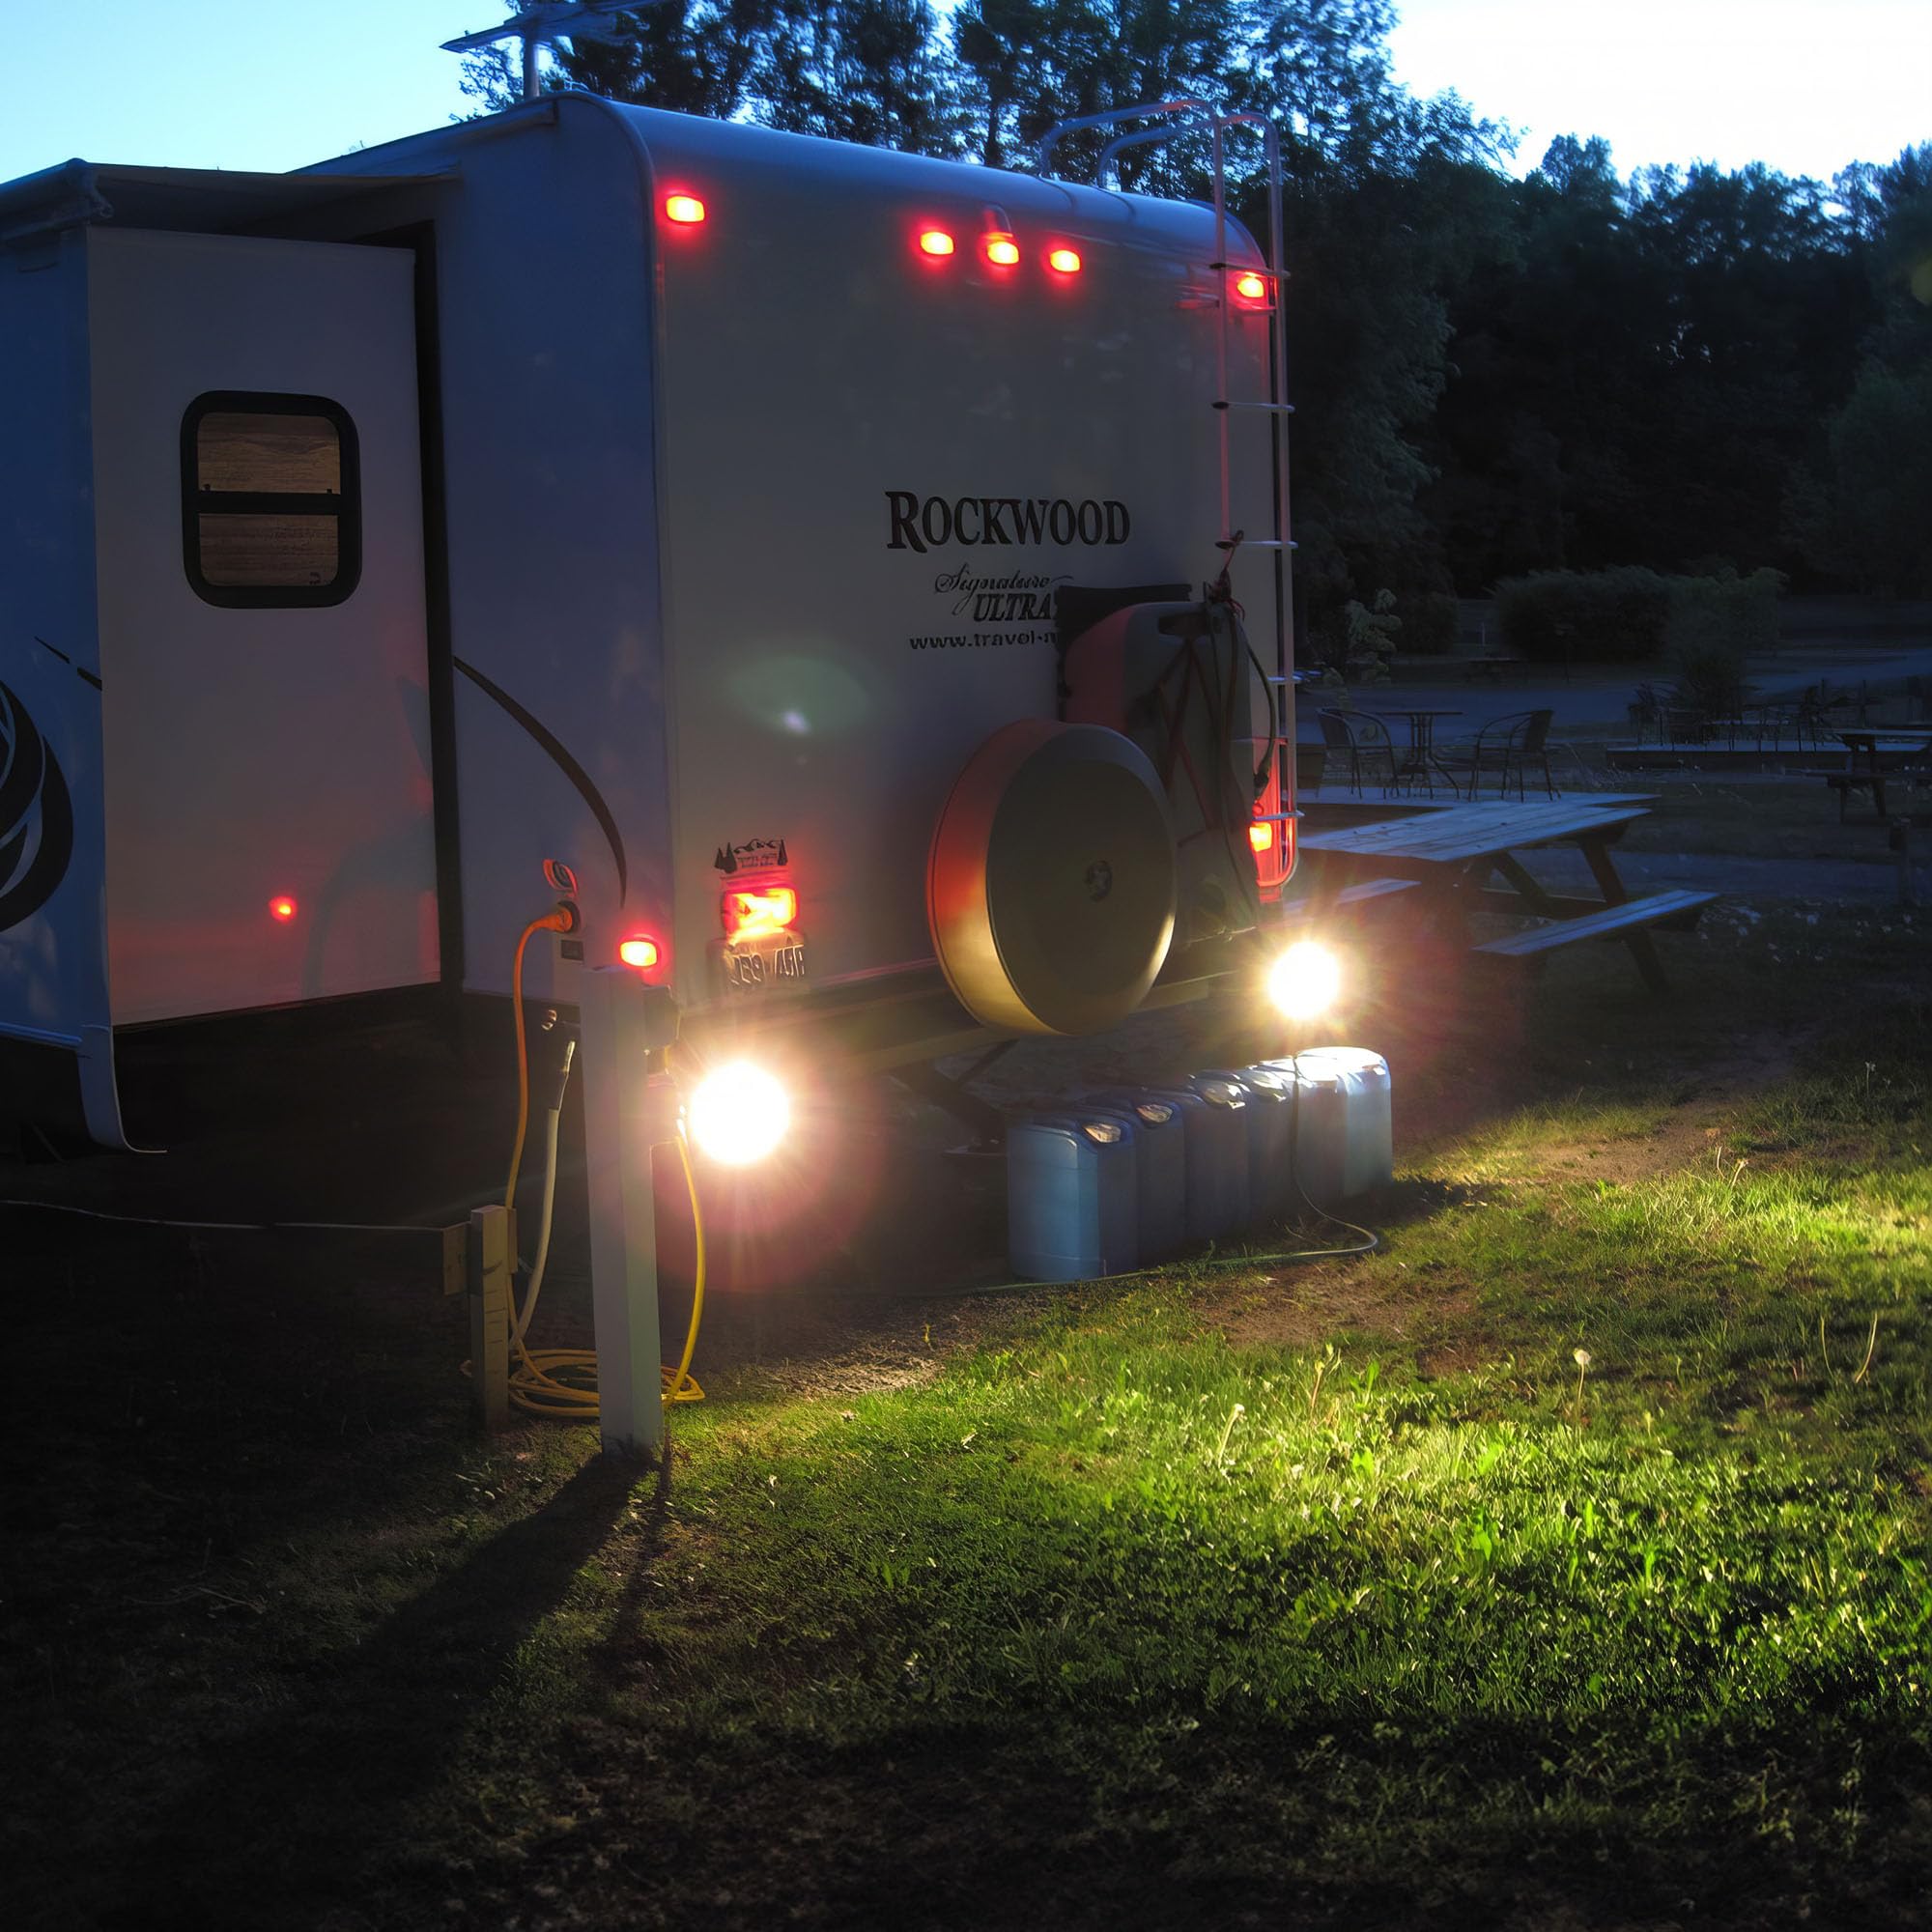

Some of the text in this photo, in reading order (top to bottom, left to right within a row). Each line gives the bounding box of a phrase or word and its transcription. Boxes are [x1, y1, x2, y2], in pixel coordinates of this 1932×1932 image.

[885, 491, 1131, 554] ROCKWOOD
[933, 562, 1071, 615] Signature
[973, 592, 1052, 622] ULTRA
